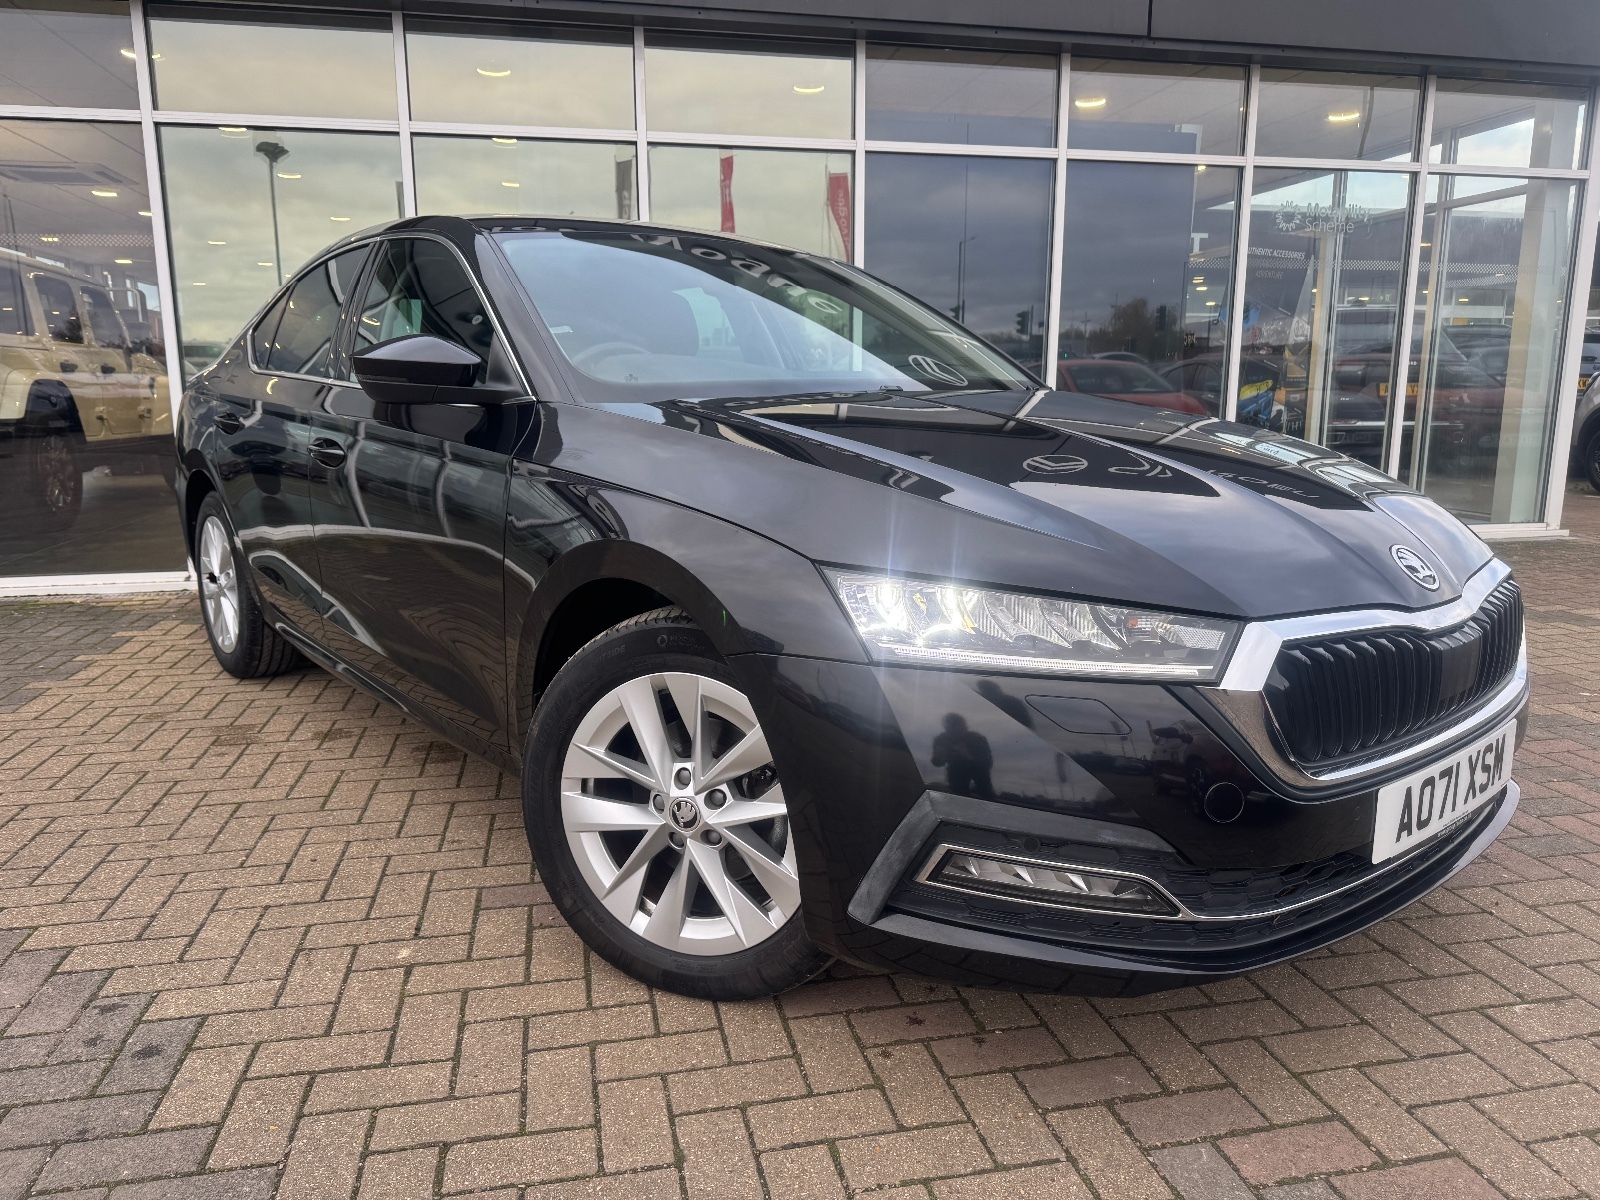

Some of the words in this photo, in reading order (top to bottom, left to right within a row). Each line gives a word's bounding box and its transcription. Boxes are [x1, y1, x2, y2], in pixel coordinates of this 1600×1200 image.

[1305, 218, 1355, 233] Scheme
[1248, 246, 1273, 257] UTHENTIC
[1272, 249, 1306, 260] ACCESSORIES
[1395, 761, 1461, 844] AO71
[1463, 733, 1507, 806] XSM
